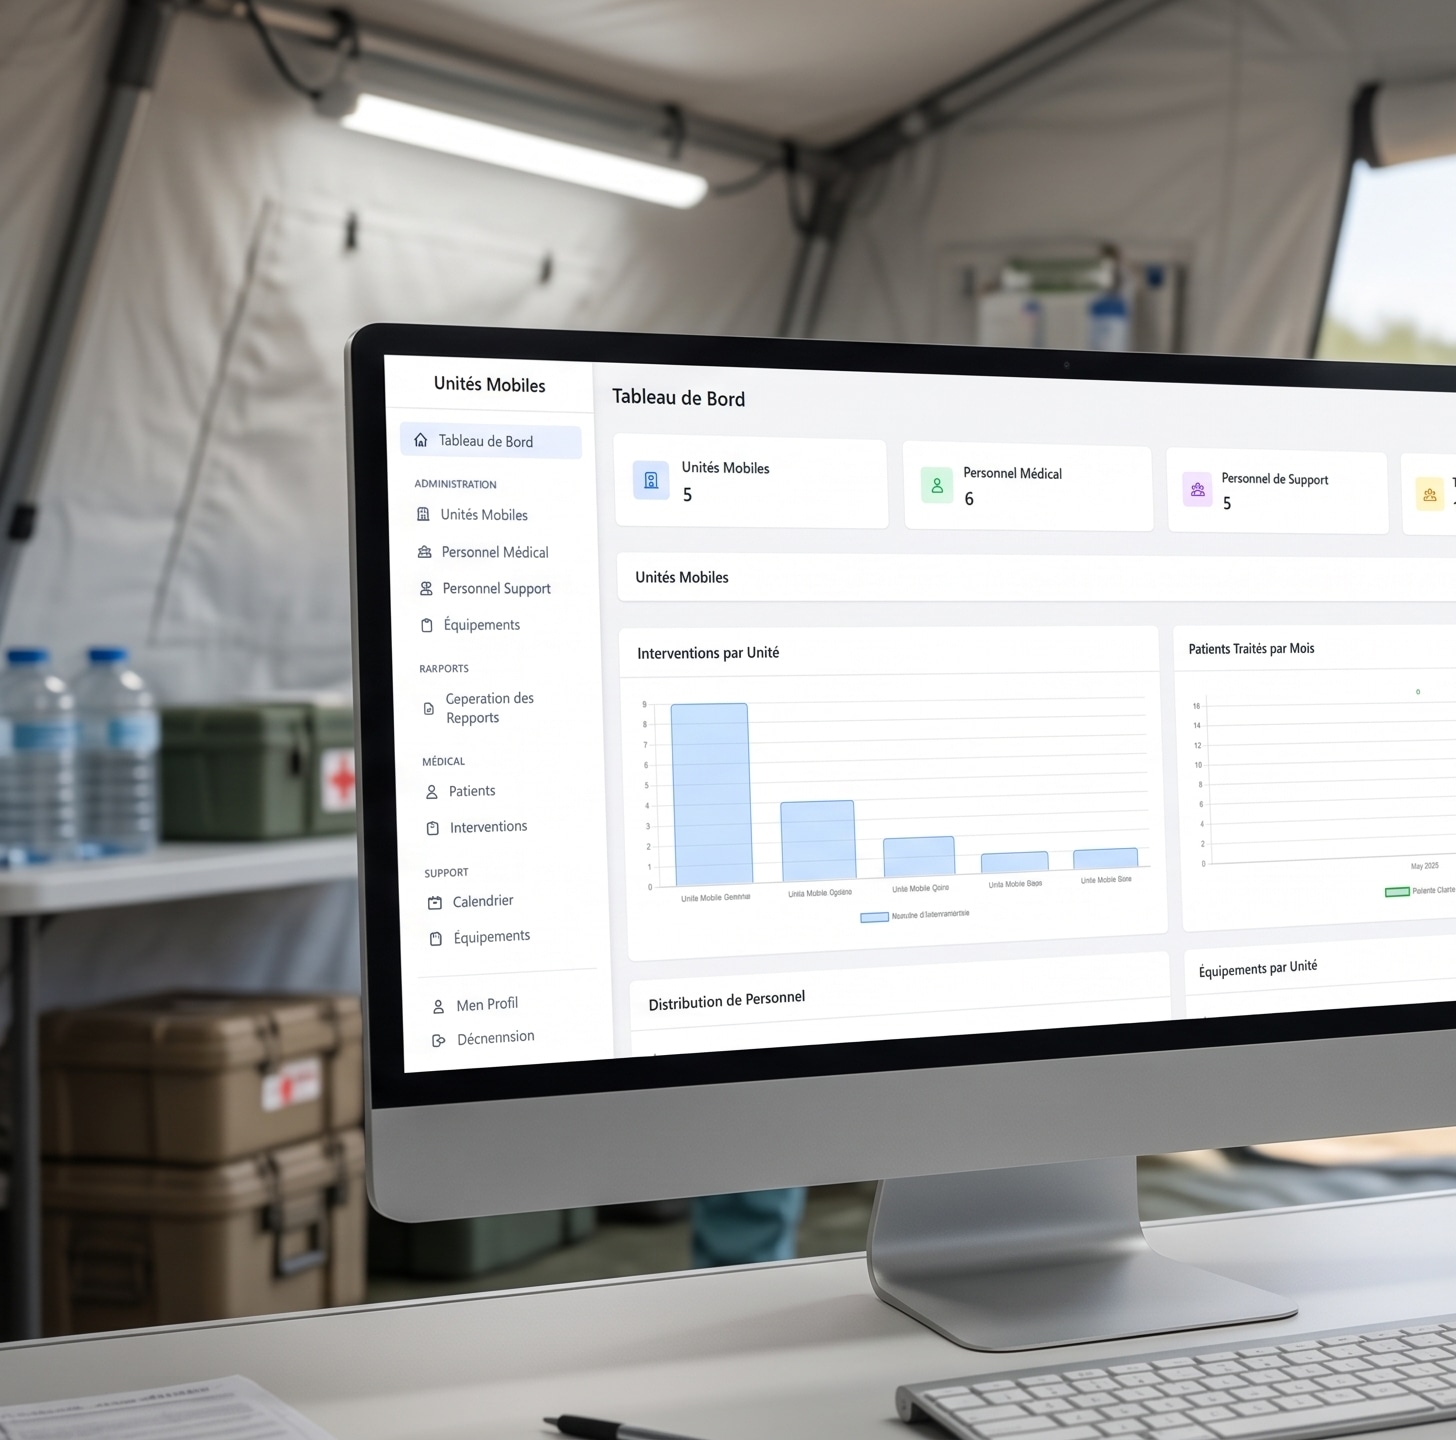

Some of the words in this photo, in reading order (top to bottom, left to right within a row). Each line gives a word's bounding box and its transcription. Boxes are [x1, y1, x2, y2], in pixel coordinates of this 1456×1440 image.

[435, 376, 481, 391] Unités
[487, 377, 545, 393] Mobiles
[612, 388, 676, 405] Tableau
[681, 389, 702, 406] de
[708, 391, 745, 407] Bord
[439, 434, 483, 446] Tableau
[487, 435, 503, 448] de
[506, 435, 533, 448] Bord
[682, 461, 719, 473] Unités
[724, 462, 770, 474] Mobiles
[964, 466, 1016, 478] Personnel
[1021, 467, 1062, 479] Médical
[415, 479, 496, 489] ADMINISTRATION
[1222, 472, 1270, 484] Personnel
[1273, 473, 1286, 486] de
[1289, 474, 1328, 487] Support
[683, 487, 692, 502] 5
[965, 491, 973, 506] 6
[1223, 496, 1231, 510] 5
[441, 508, 478, 520] Unités
[482, 508, 528, 521] Mobiles
[443, 545, 499, 558] Personnel
[504, 546, 548, 558] Médical
[636, 570, 675, 583] Unités
[680, 571, 729, 583] Mobiles
[443, 582, 500, 594] Personnel
[504, 582, 551, 597] Support
[445, 616, 520, 633] Équipements
[638, 646, 719, 659] Interventions
[724, 650, 743, 662] par
[747, 646, 779, 658] Unité
[1189, 643, 1230, 654] Patients
[1233, 643, 1267, 654] Traités
[1270, 646, 1287, 657] par
[1290, 642, 1314, 653] Mois
[514, 691, 534, 704] des
[447, 712, 499, 726] Repports
[423, 755, 465, 766] MÉDICAL
[450, 785, 495, 797] Patients
[451, 820, 527, 833] Interventions
[425, 868, 469, 878] SUPPORT
[453, 894, 514, 908] Calendrier
[455, 930, 530, 947] Équipements
[1200, 964, 1267, 980] Équipements
[1270, 964, 1287, 976] par
[1290, 959, 1317, 972] Unité
[457, 1000, 483, 1012] Men
[488, 996, 518, 1010] Profil
[649, 996, 722, 1011] Distribution
[726, 993, 742, 1007] de
[746, 989, 805, 1005] Personnel
